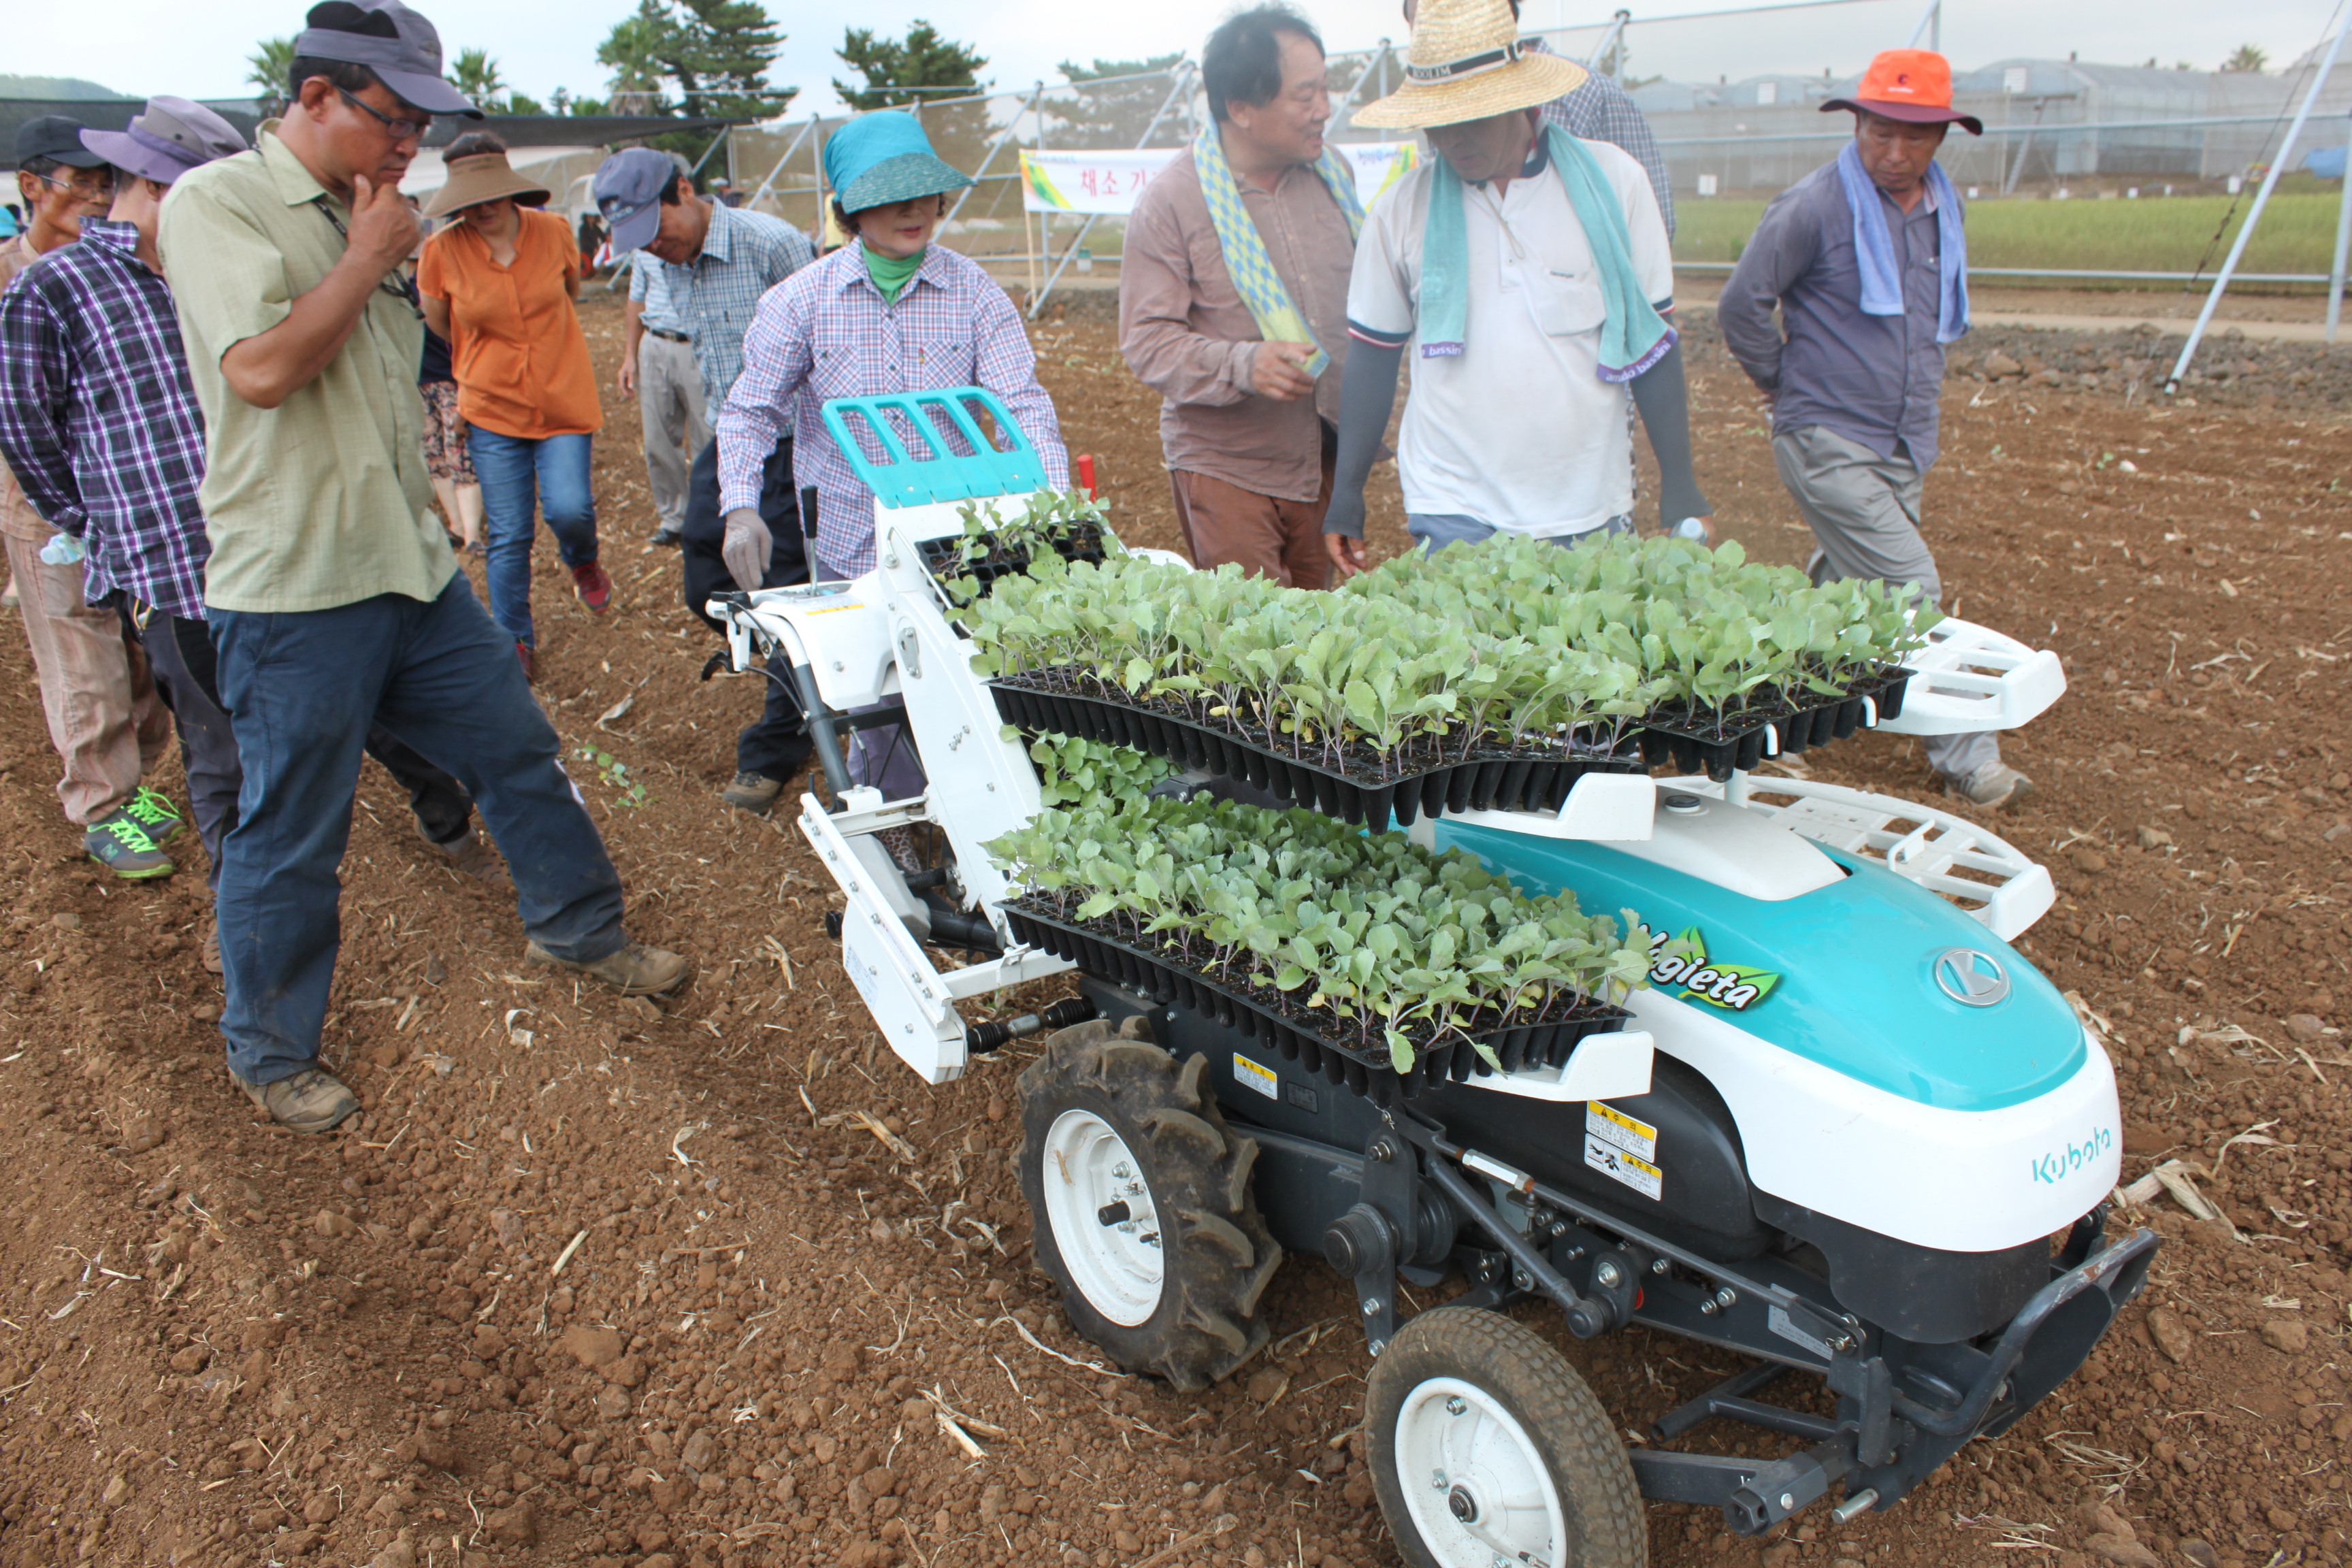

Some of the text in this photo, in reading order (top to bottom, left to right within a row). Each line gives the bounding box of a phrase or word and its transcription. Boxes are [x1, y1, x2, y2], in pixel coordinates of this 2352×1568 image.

[1081, 168, 1158, 197] 채소 기
[1636, 340, 1671, 374] bassini
[1638, 923, 1760, 1011] gieta
[2031, 1126, 2110, 1183] Kubota
